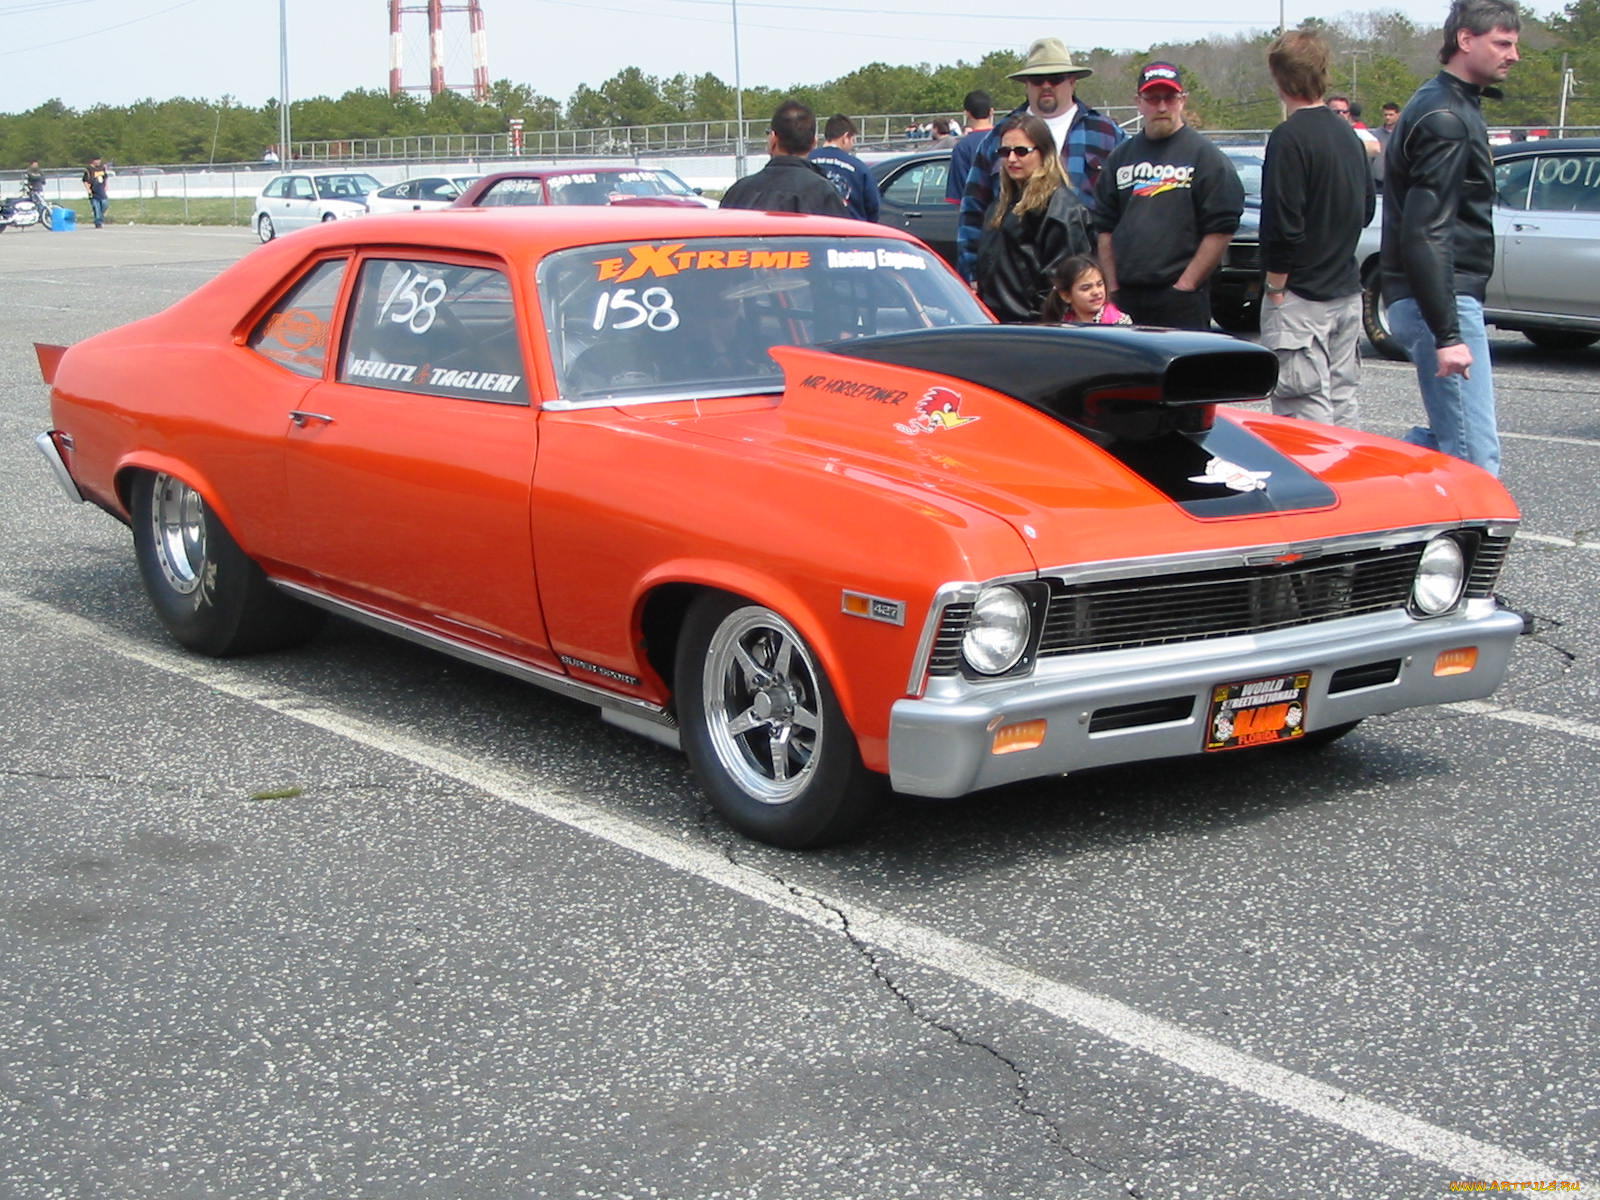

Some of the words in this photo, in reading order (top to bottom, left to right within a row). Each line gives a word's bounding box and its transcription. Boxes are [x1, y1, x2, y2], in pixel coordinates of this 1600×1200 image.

[827, 249, 876, 270] Racing
[377, 269, 447, 334] 158
[592, 287, 680, 331] 158
[348, 359, 418, 382] KEILITZ
[429, 367, 521, 393] TAGLIERI
[825, 379, 909, 405] HORSEPOWER
[1241, 679, 1285, 697] WORLD
[1238, 730, 1280, 745] FLORIDA
